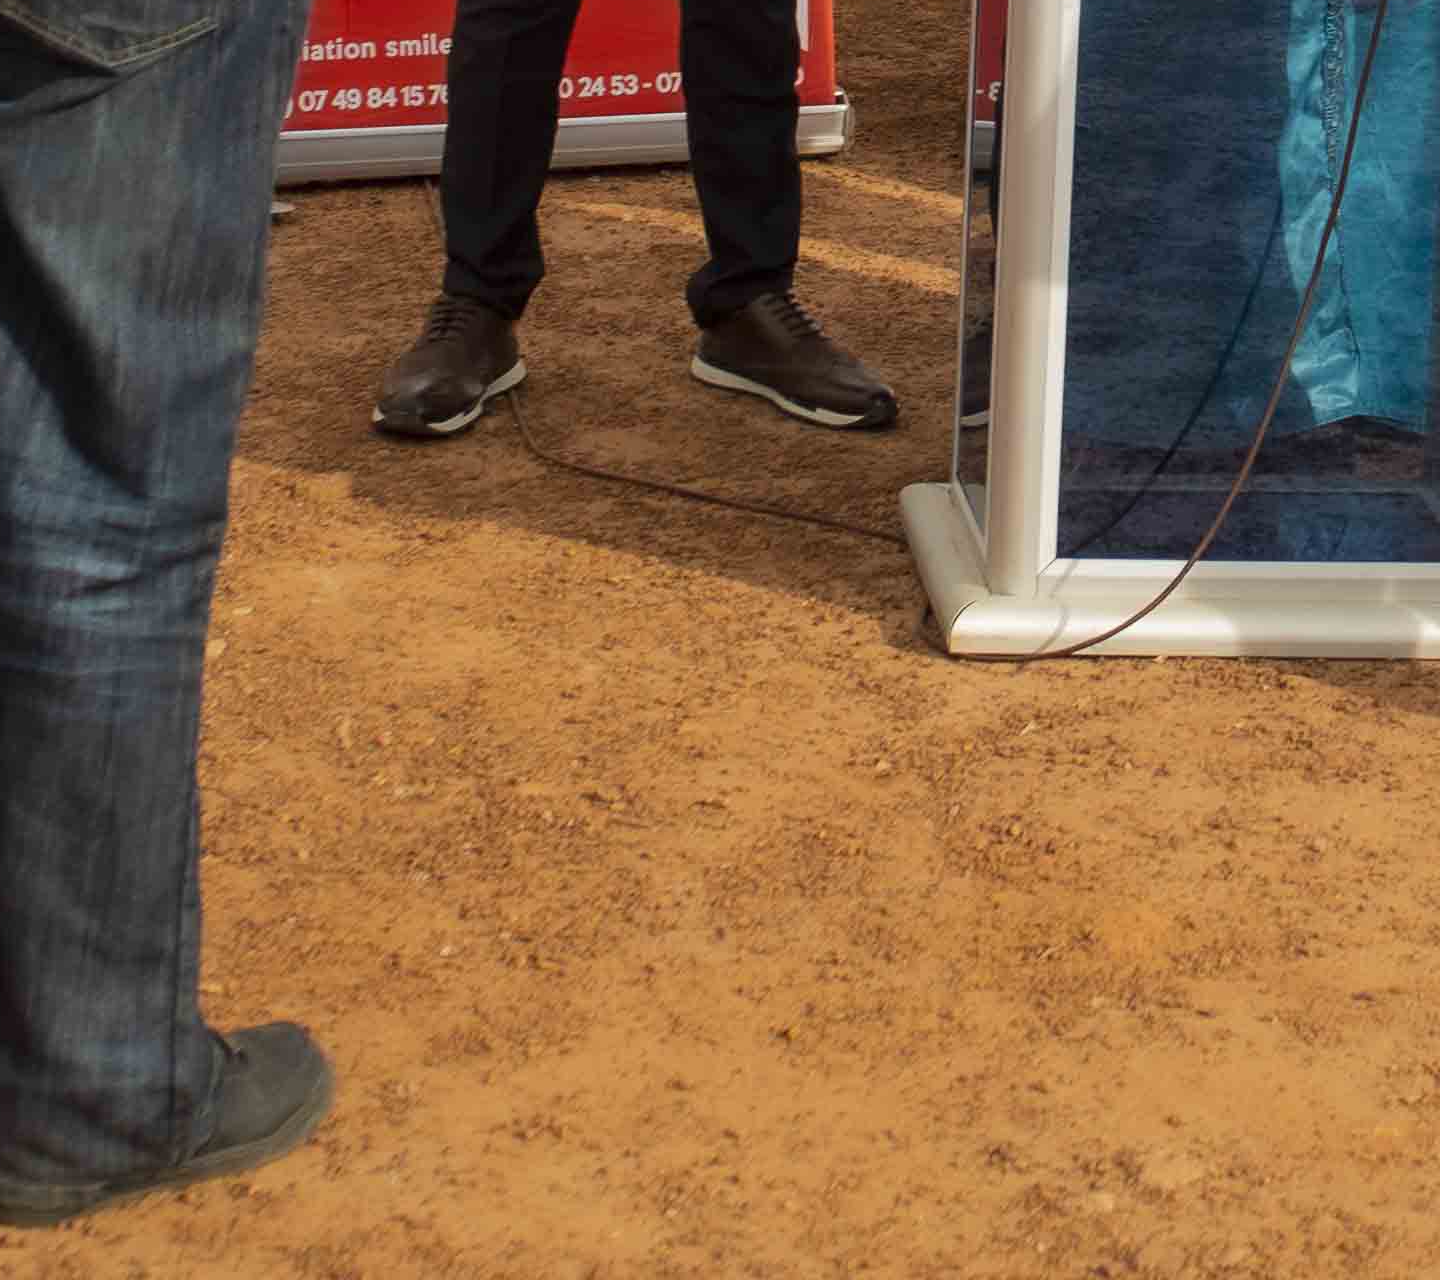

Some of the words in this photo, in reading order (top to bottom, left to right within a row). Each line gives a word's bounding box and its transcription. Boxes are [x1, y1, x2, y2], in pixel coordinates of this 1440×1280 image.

[302, 37, 377, 62] iation
[383, 32, 454, 58] smile
[297, 89, 329, 113] 07
[331, 88, 362, 111] 49
[366, 87, 398, 109] 84
[400, 85, 425, 107] 15
[577, 75, 607, 98] 24
[610, 73, 639, 96] 53
